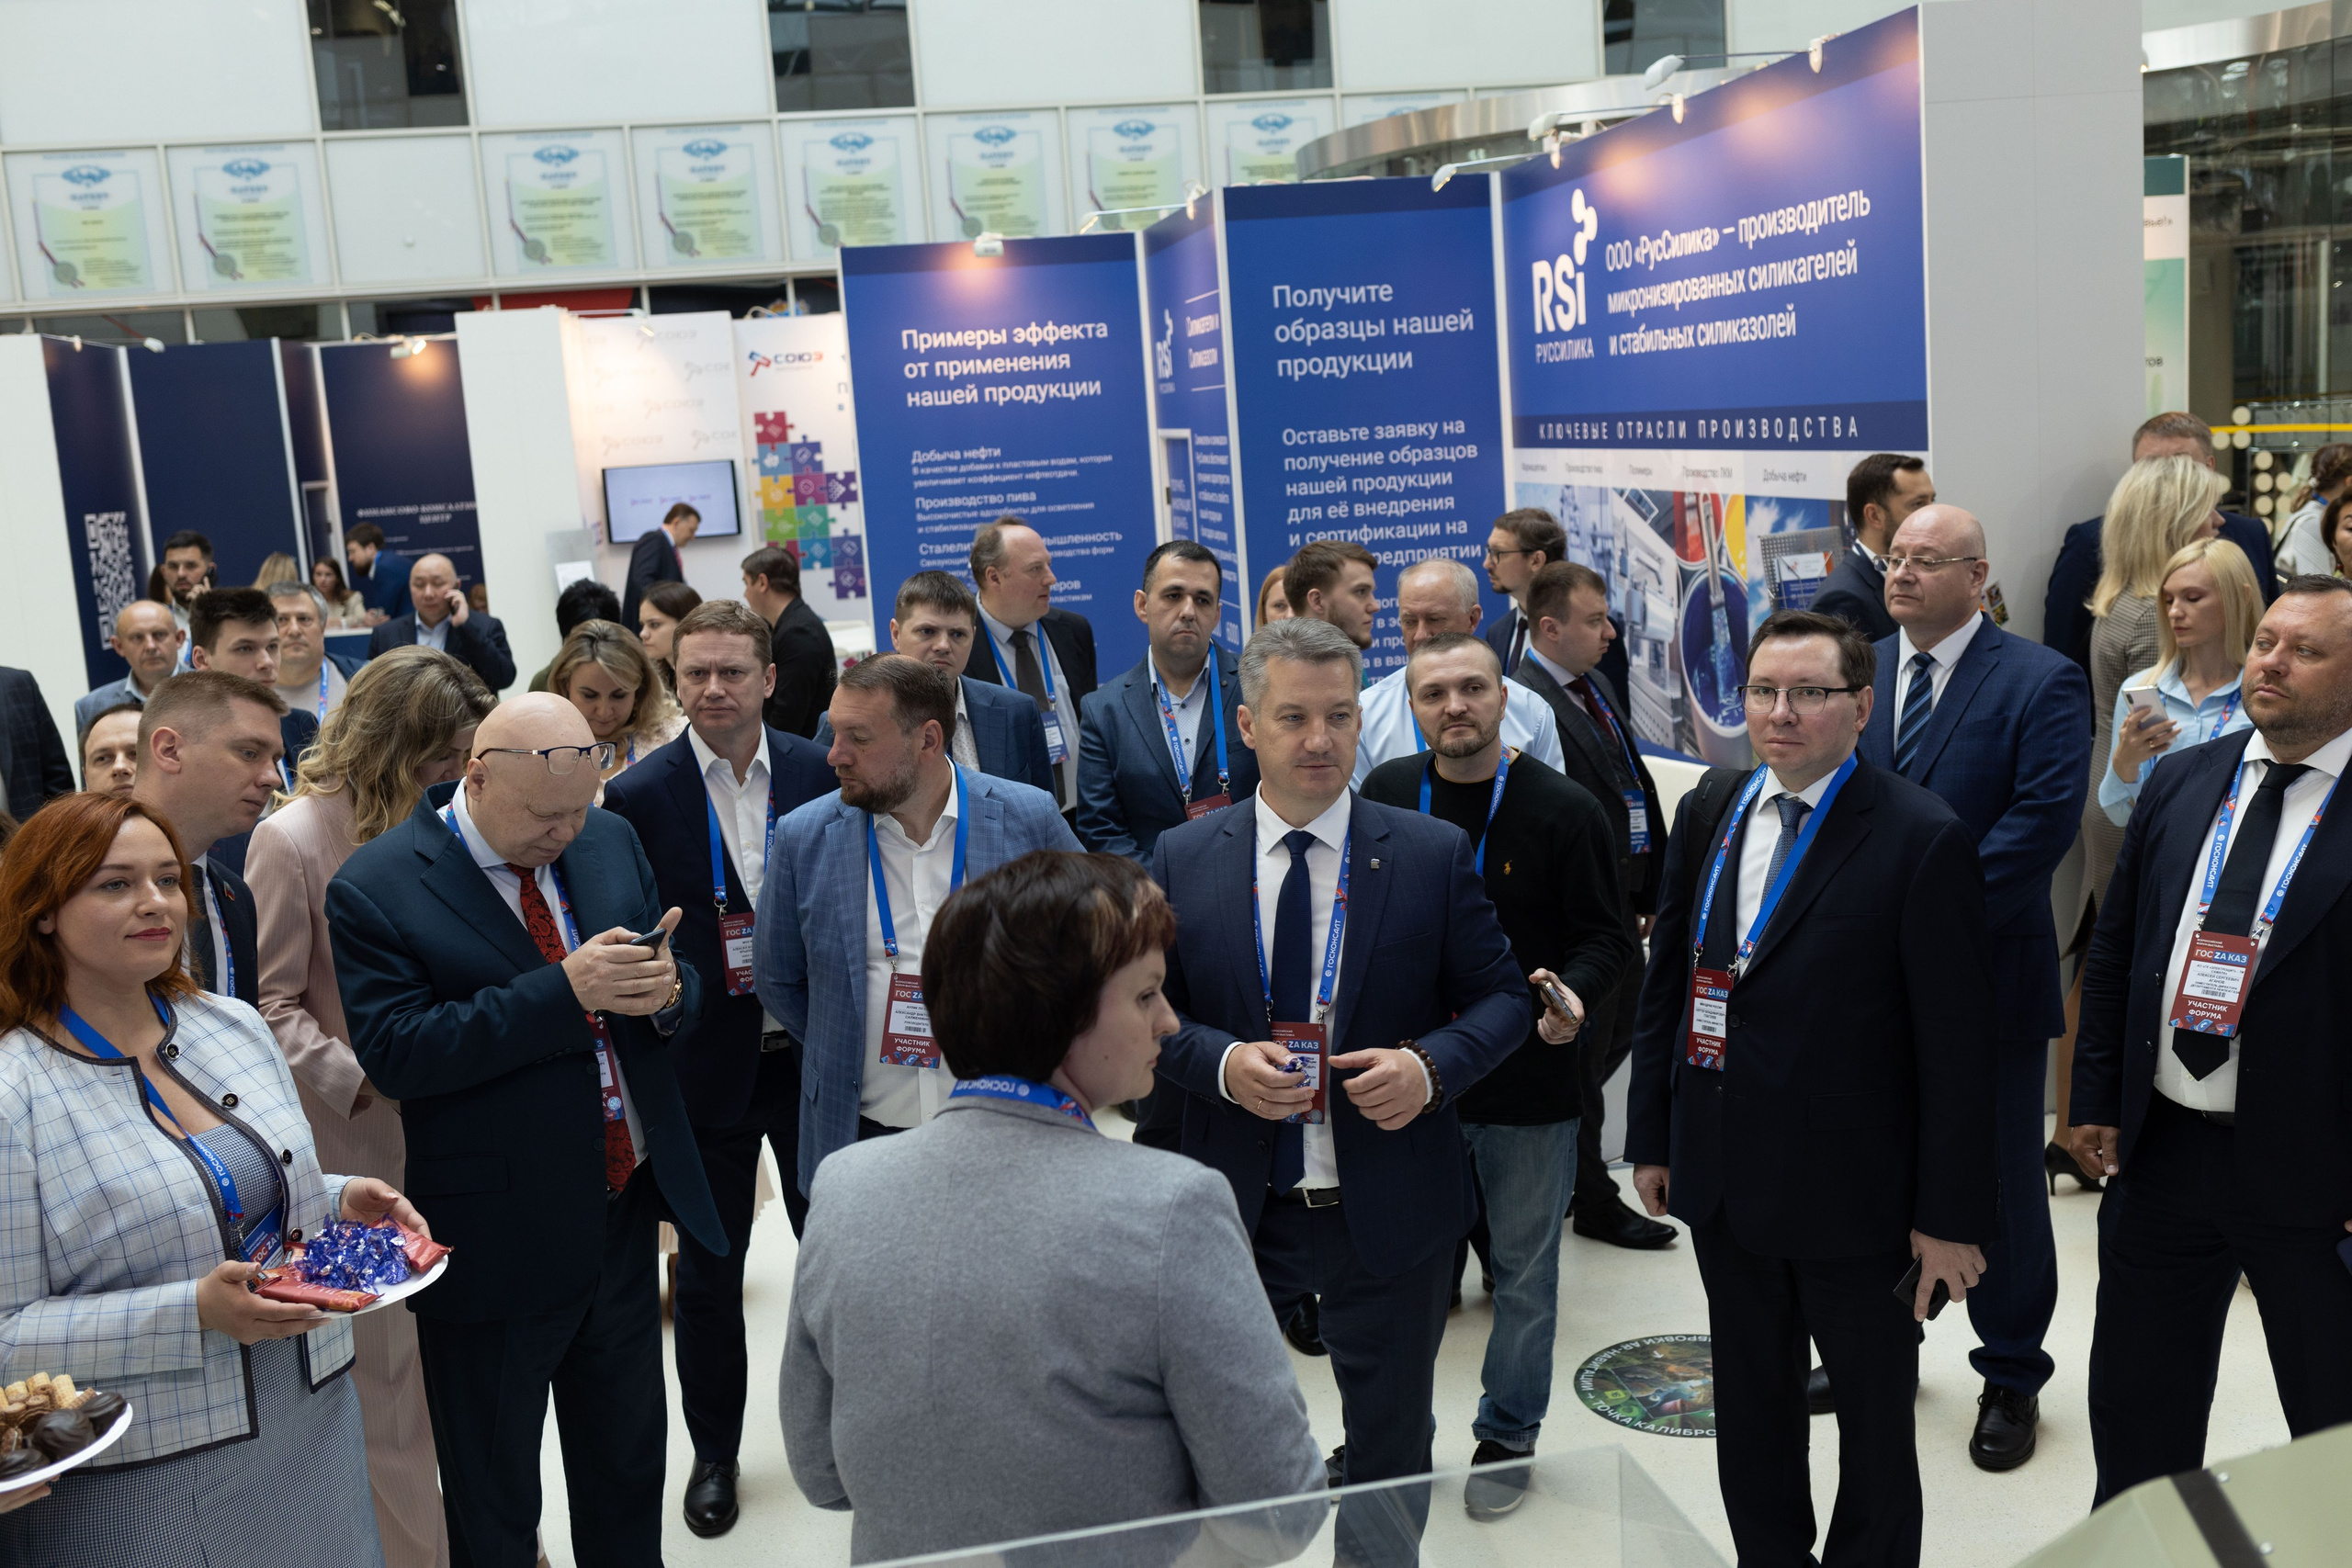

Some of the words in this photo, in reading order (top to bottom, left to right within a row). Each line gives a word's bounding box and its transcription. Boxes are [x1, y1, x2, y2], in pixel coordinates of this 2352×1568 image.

[1605, 241, 1633, 272] ООО
[1634, 225, 1720, 270] «РусСилика»
[1738, 189, 1871, 249] производитель
[1607, 268, 1747, 318] микронизированных
[1747, 239, 1859, 292] силикагелей
[1272, 281, 1394, 311] Получите
[901, 330, 1008, 355] Примеры
[1012, 320, 1109, 347] эффекта
[1274, 319, 1385, 344] образцы
[1393, 308, 1474, 335] нашей
[1609, 333, 1618, 356] и
[1619, 322, 1695, 355] стабильных
[1697, 303, 1796, 348] силиказолей
[1535, 336, 1595, 365] РУССИЛИКА
[904, 362, 930, 378] от
[934, 352, 1071, 380] применения
[1277, 349, 1414, 381] продукции
[906, 384, 979, 408] нашей
[984, 379, 1102, 407] продукции
[1283, 427, 1370, 446] Оставьте
[1374, 424, 1438, 444] заявку
[1443, 421, 1466, 435] на
[1539, 422, 1609, 440] КЛЮЧЕВЫЕ
[1616, 419, 1688, 439] ОТРАСЛИ
[1698, 416, 1860, 443] ПРОИЗВОДСТВА
[911, 449, 962, 465] Добыча
[965, 446, 1001, 462] нефти
[918, 465, 958, 475] качестве
[959, 462, 994, 474] добавки
[1284, 453, 1385, 472] получение
[1388, 444, 1479, 468] образцов
[967, 472, 1023, 486] коэффициент
[1286, 475, 1348, 497] нашей
[1351, 471, 1453, 494] продукции
[1762, 468, 1787, 482] Добыча
[1788, 469, 1808, 485] нефти
[915, 493, 1004, 511] Производство
[1006, 491, 1037, 502] пива
[916, 510, 978, 522] Высокочистые
[1030, 504, 1047, 515] для
[1287, 507, 1323, 525] для
[1327, 502, 1351, 519] её
[1354, 496, 1456, 518] внедрения
[1289, 535, 1301, 547] и
[1306, 523, 1442, 545] сертификации
[1446, 520, 1469, 536] на
[1375, 544, 1482, 567] редприятии
[2207, 842, 2223, 889] ГОСКОНСАЛТ
[2281, 843, 2308, 889] ГОСКОНСАЛТ
[1704, 864, 1721, 911] ГОСКОНСАЛТ
[1328, 919, 1341, 968] ГОСКОНСАЛТ
[2188, 1000, 2229, 1012] УЧАСТНИК
[2188, 1009, 2222, 1020] ФОРУМА
[894, 1038, 931, 1047] УЧАСТНИК
[896, 1045, 926, 1055] ФОРУМА
[1696, 1037, 1722, 1048] УЧАСТНИК
[1698, 1046, 1719, 1055] ФОРУМА
[1592, 1400, 1633, 1425] ТОЧКА
[1634, 1420, 1716, 1437] КАЛИБРО
